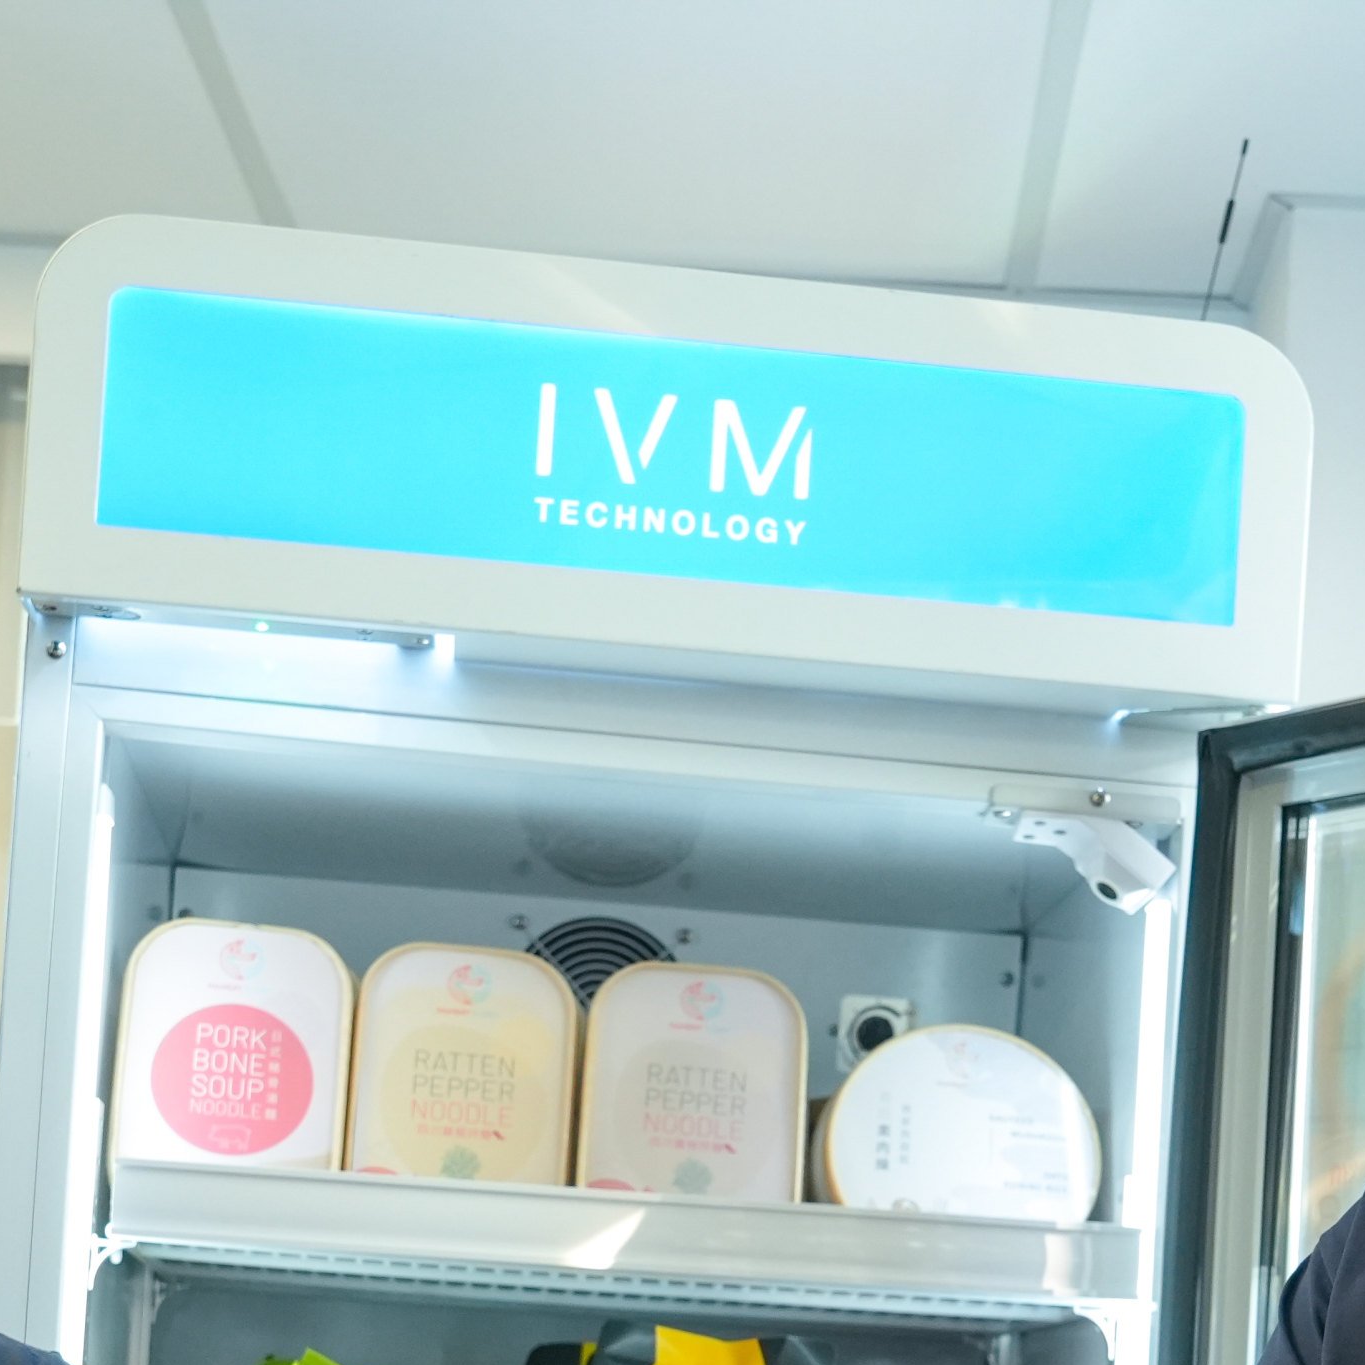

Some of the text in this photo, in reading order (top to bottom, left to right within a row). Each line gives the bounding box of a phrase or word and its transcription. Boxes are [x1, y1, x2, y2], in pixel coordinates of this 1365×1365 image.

[535, 382, 813, 500] IVM
[533, 496, 807, 546] TECHNOLOGY
[195, 1022, 267, 1050] PORK
[192, 1048, 266, 1077] BONE
[414, 1049, 516, 1078] RATTEN
[646, 1062, 748, 1092] RATTEN
[190, 1074, 264, 1100] SOUP
[412, 1073, 515, 1104] PEPPER
[644, 1087, 747, 1116] PEPPER
[189, 1099, 262, 1120] NOODLE
[410, 1098, 514, 1128] NOODLE
[642, 1112, 745, 1141] NOODLE
